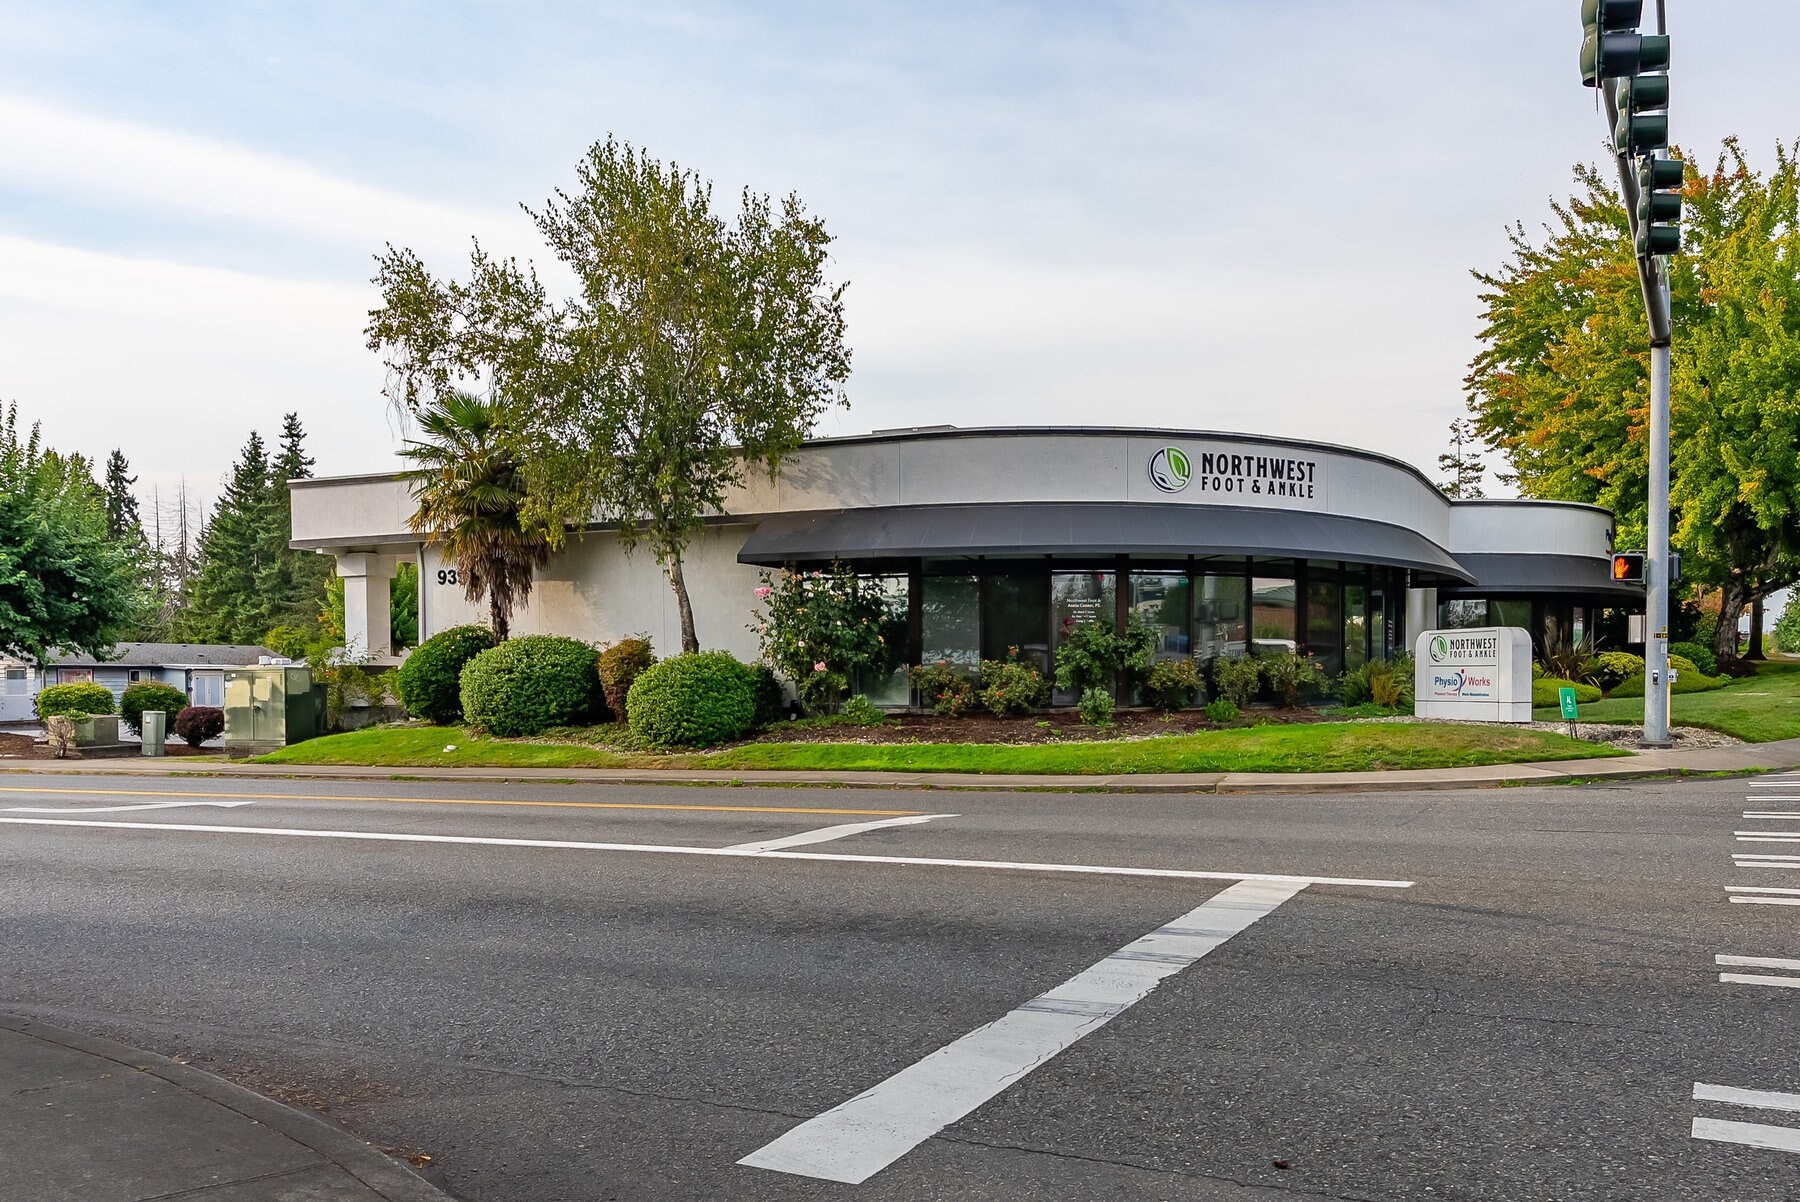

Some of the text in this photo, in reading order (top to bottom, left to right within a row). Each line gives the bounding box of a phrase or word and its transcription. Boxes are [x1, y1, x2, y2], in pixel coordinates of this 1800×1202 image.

[1201, 452, 1316, 483] NORTHWEST
[1201, 476, 1314, 499] FOOT & ANKLE
[437, 569, 461, 585] 93
[1449, 637, 1497, 650] NORTHWEST
[1449, 649, 1496, 658] FOOT & ANKLE
[1434, 676, 1491, 688] Physio Works
